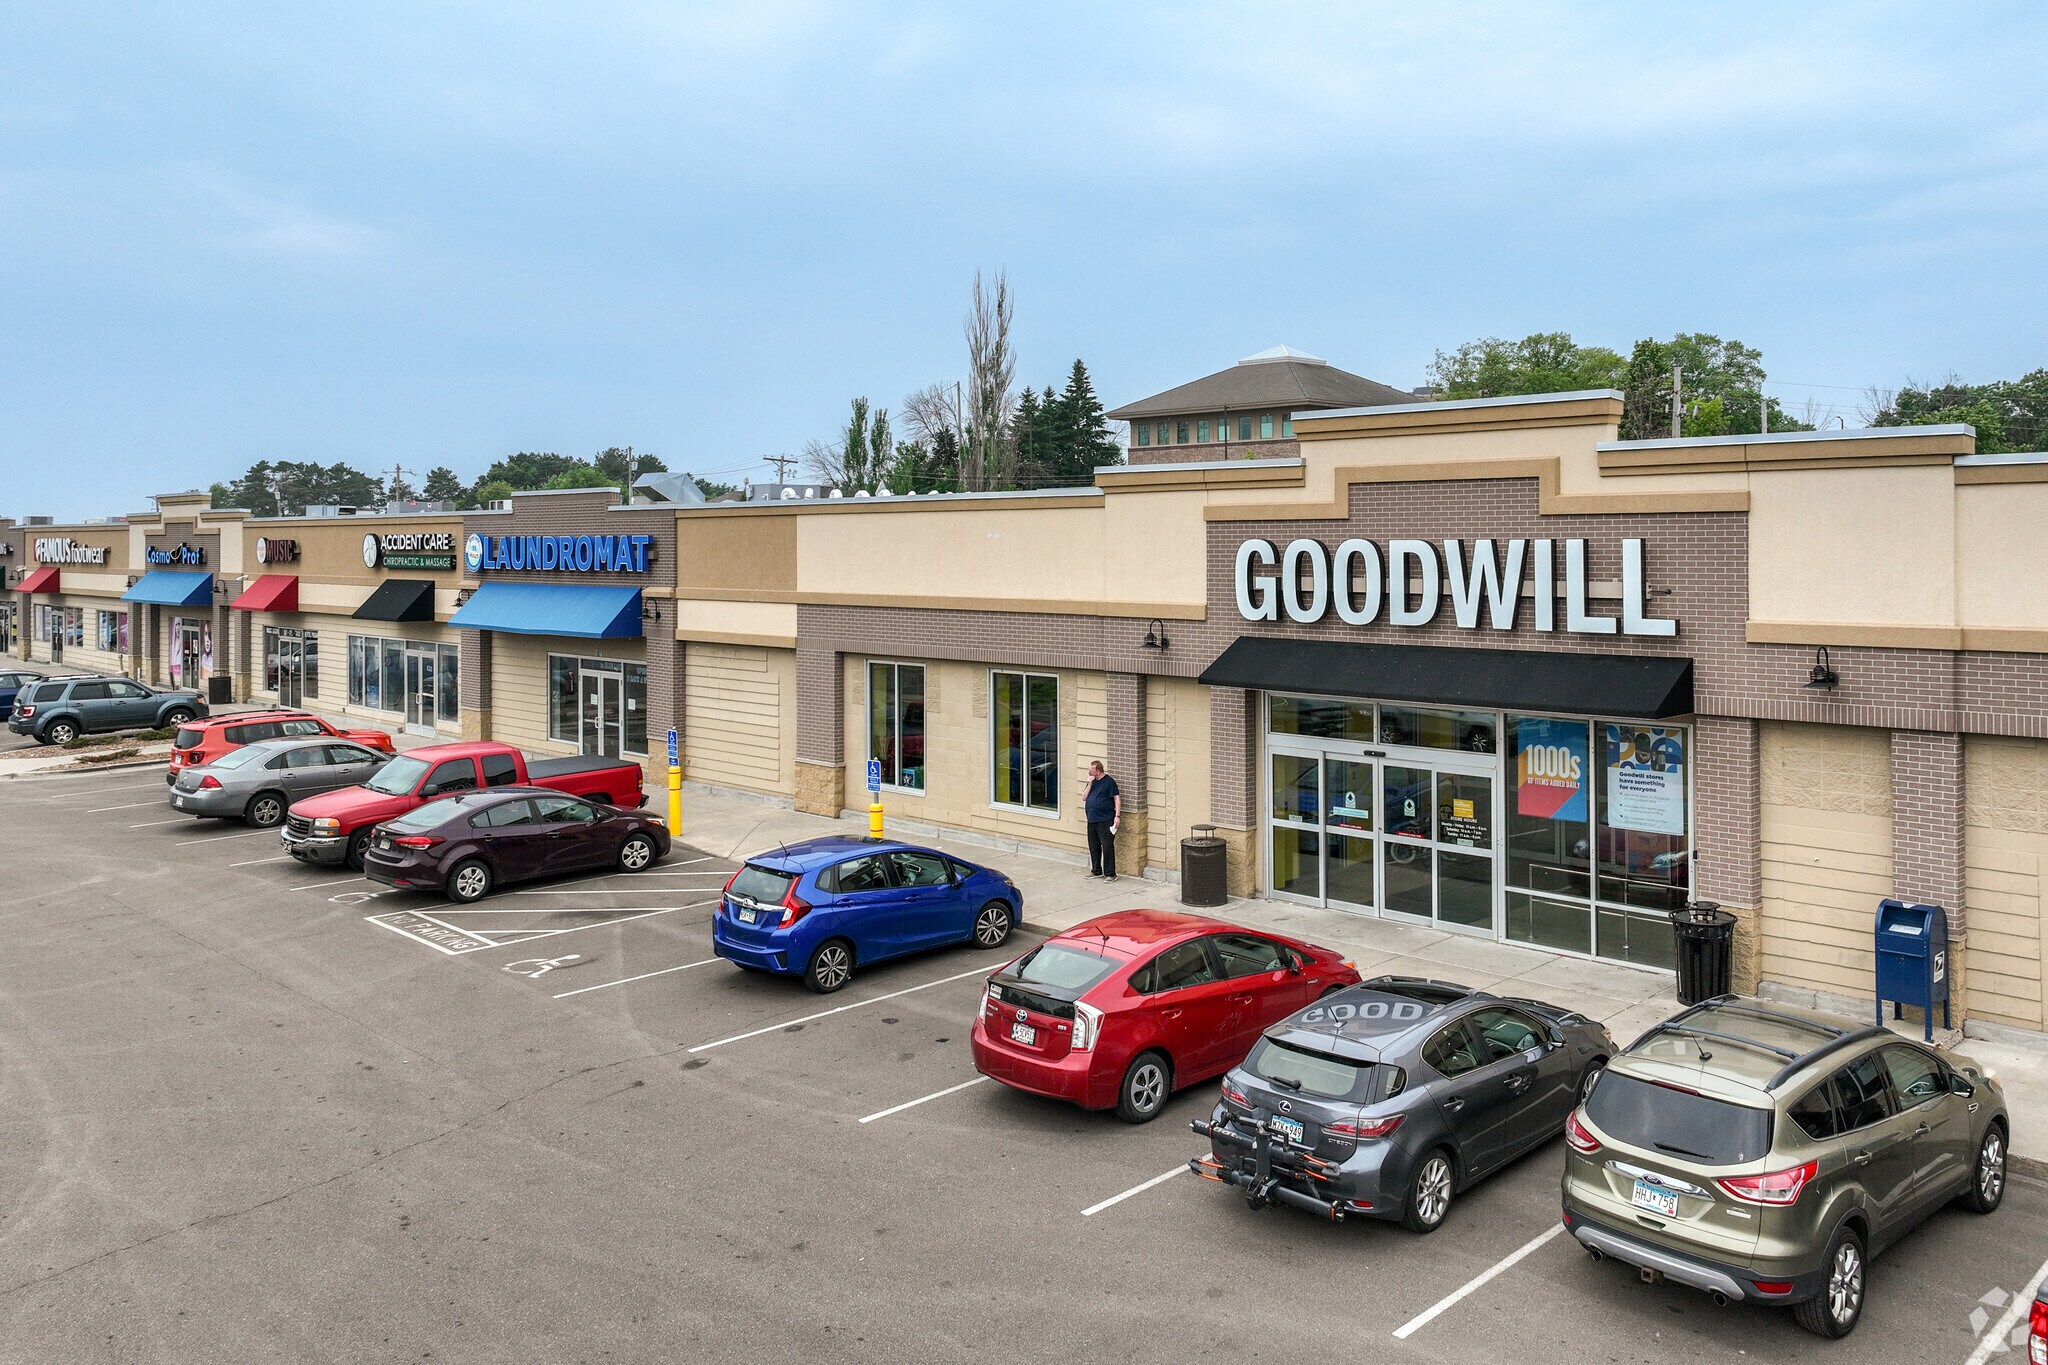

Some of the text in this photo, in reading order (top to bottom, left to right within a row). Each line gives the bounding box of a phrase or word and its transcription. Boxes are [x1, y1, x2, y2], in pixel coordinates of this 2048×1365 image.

[40, 537, 105, 564] FAMOUS footwear
[380, 534, 423, 550] ACCIDENT
[423, 533, 449, 550] CARE
[147, 545, 200, 565] Cosmo Prof
[266, 540, 293, 562] MUSIC
[483, 534, 649, 572] LAUNDROMAT
[383, 556, 419, 566] CHIROPRACTIC
[425, 558, 451, 567] MASSAGE
[1234, 538, 1677, 636] GOODWILL
[1534, 777, 1549, 786] ITEMS
[1549, 779, 1566, 788] ADDED
[1565, 781, 1580, 789] DAILY
[1619, 771, 1645, 779] Goodwill
[1634, 779, 1666, 788] something
[1630, 785, 1657, 793] everyone
[404, 922, 479, 950] PARKING
[1289, 1124, 1302, 1138] 949
[1635, 1187, 1653, 1203] HHJ
[1658, 1193, 1675, 1209] 758
